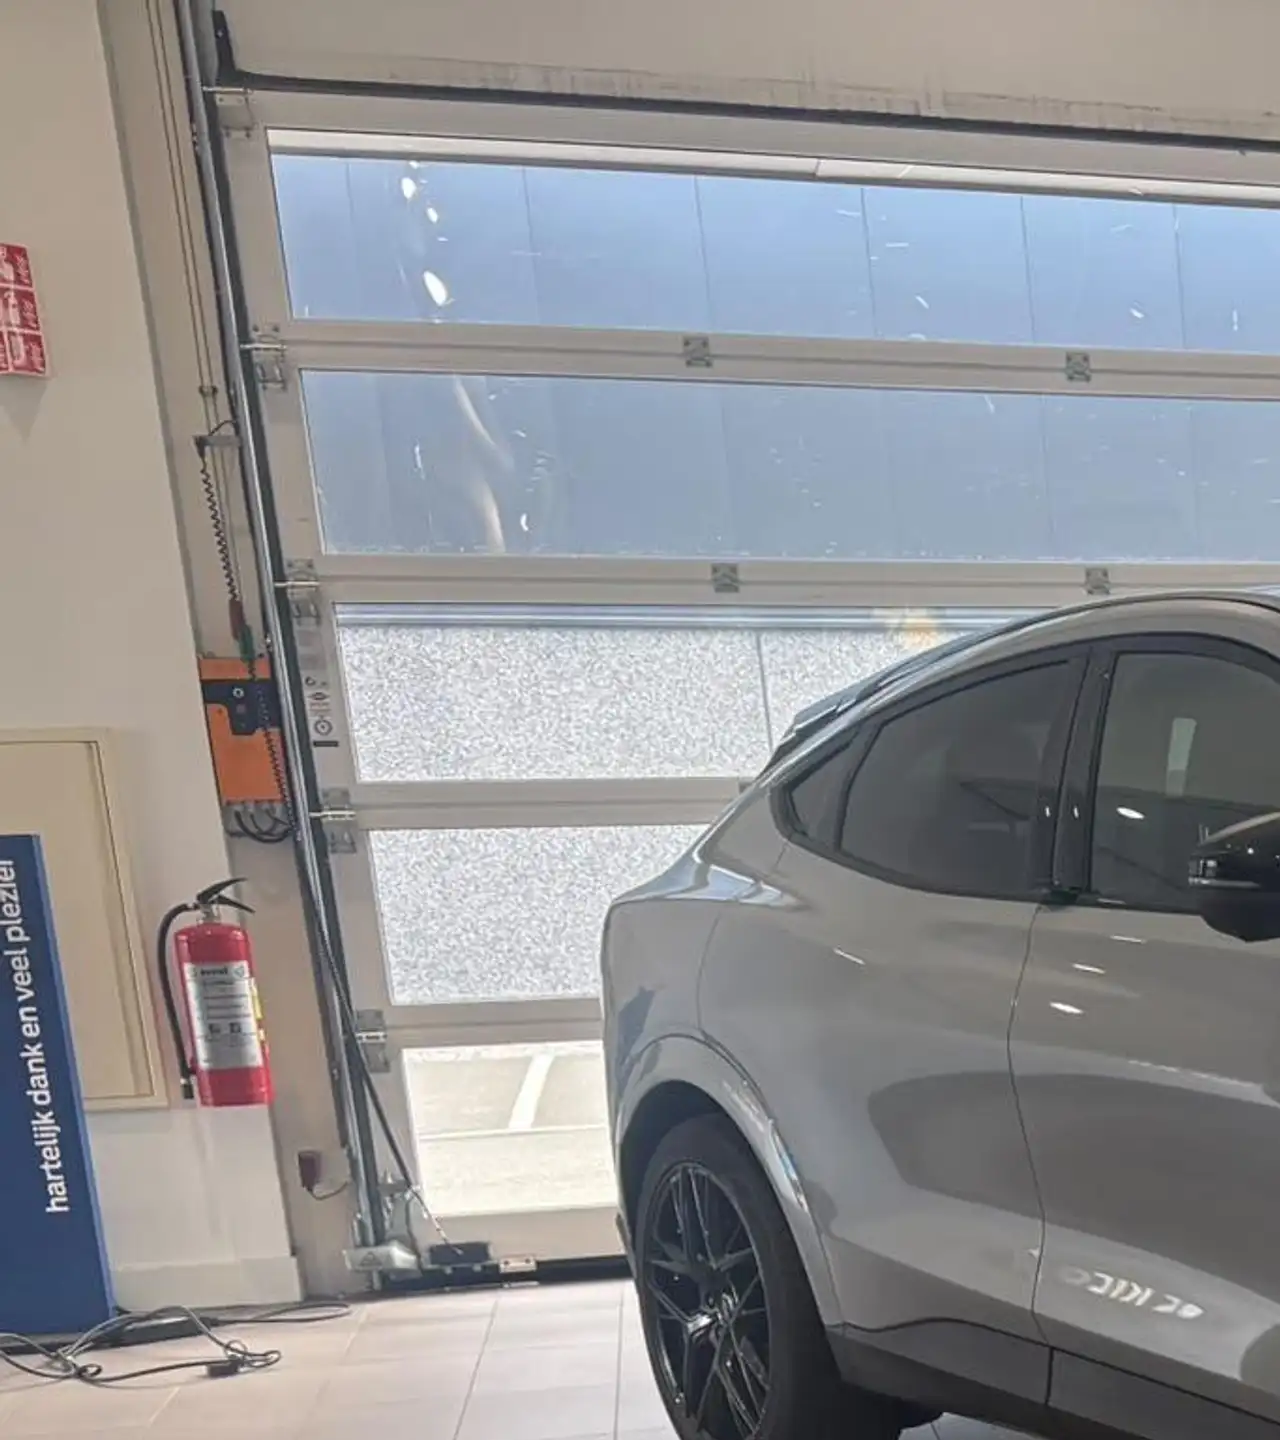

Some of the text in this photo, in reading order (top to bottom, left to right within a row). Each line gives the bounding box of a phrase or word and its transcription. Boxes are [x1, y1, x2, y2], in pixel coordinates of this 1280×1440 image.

[4, 947, 35, 1002] veel
[18, 1006, 41, 1038] en
[19, 1042, 52, 1106] dank
[31, 1109, 70, 1213] hartelijk
